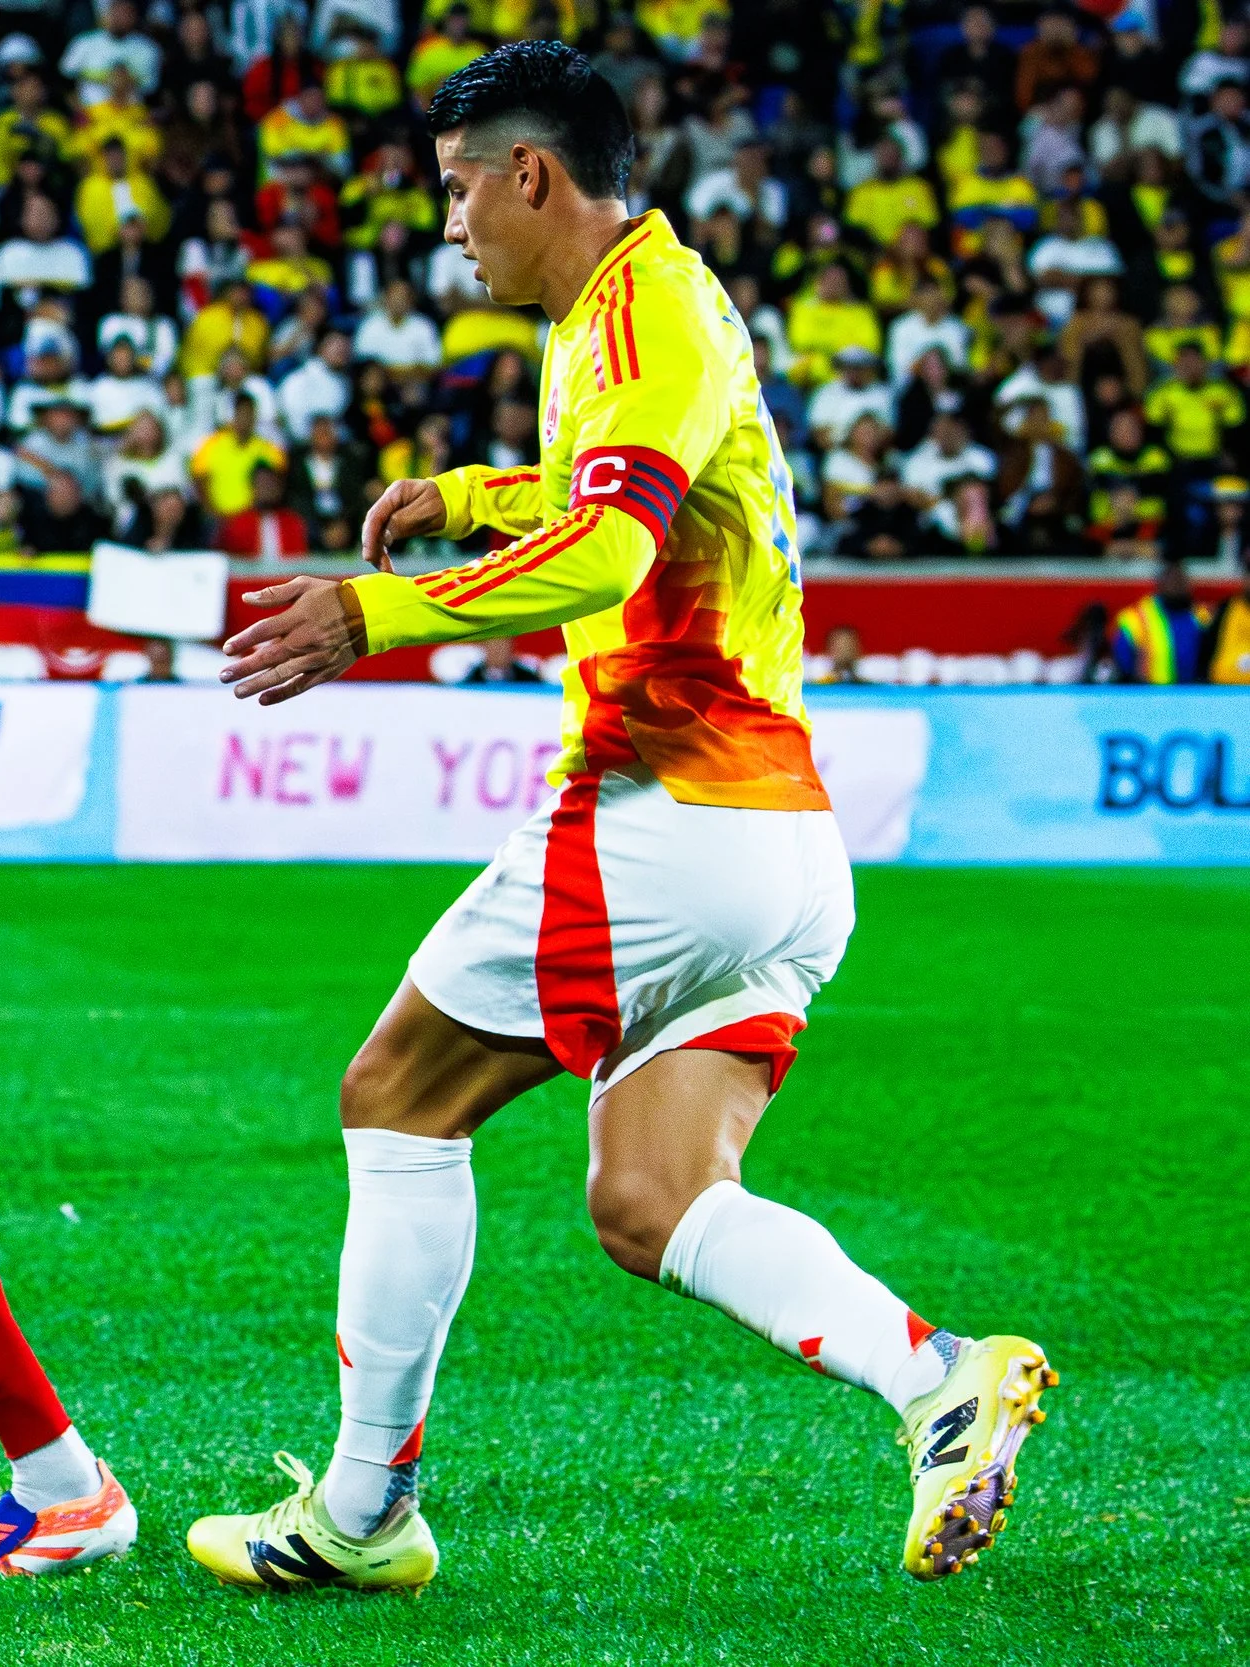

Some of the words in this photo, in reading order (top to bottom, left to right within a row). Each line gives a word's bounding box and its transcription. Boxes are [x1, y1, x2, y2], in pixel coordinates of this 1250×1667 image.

[579, 455, 627, 497] C
[216, 732, 376, 806] NEW
[428, 736, 562, 811] YOR
